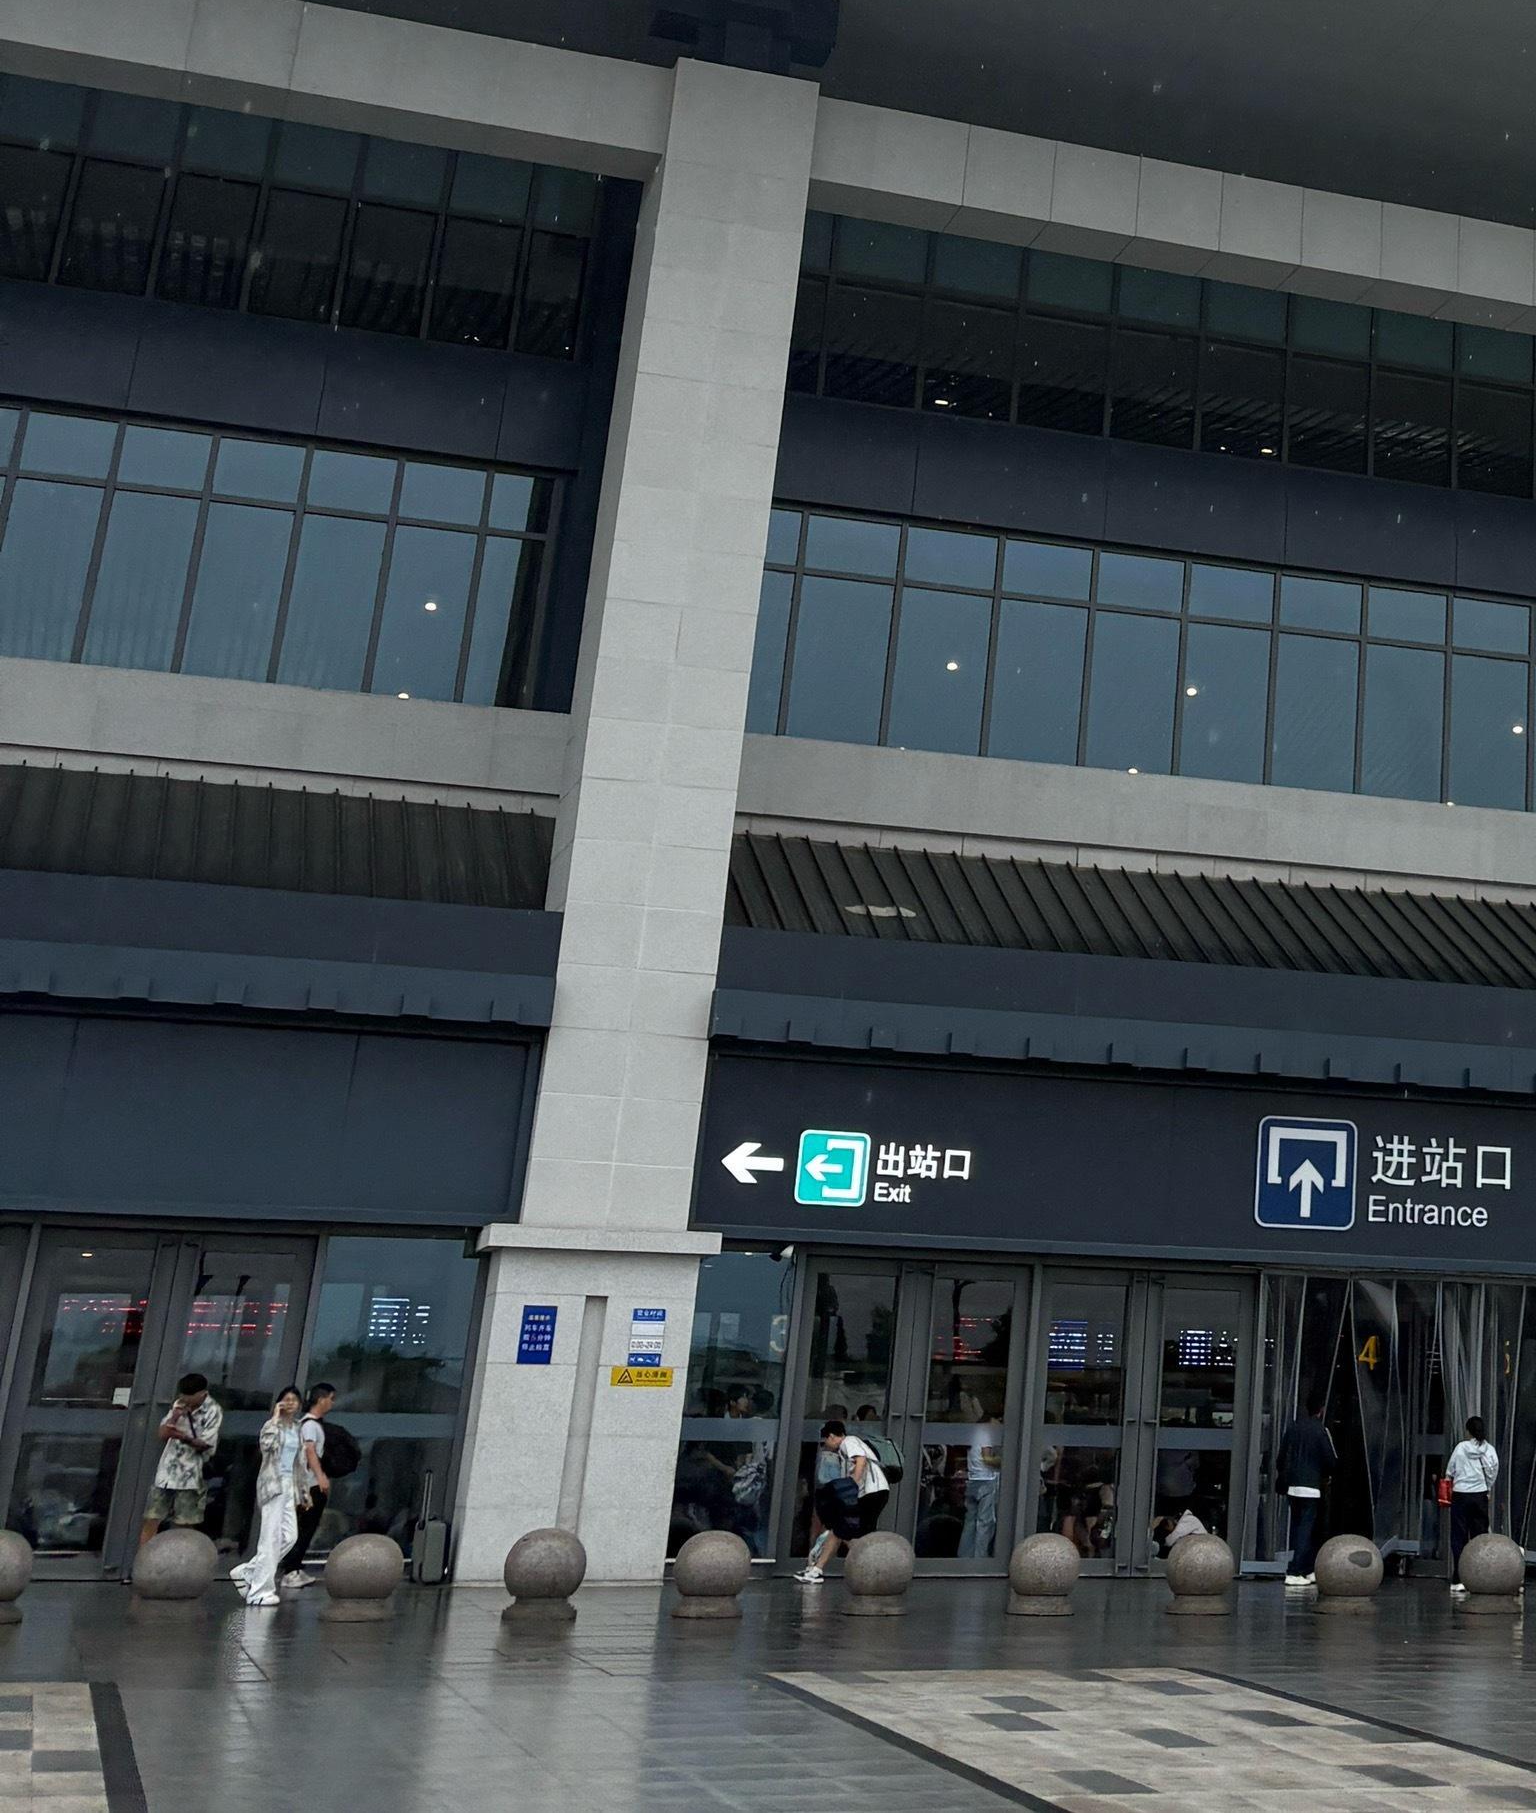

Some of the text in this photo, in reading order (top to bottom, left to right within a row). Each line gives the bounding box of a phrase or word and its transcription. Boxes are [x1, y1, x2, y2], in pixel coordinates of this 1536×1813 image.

[876, 1142, 971, 1180] 出站口
[1371, 1135, 1511, 1189] 进站口
[873, 1182, 911, 1203] Exit
[1368, 1195, 1488, 1227] Entrance
[1358, 1336, 1378, 1370] 4
